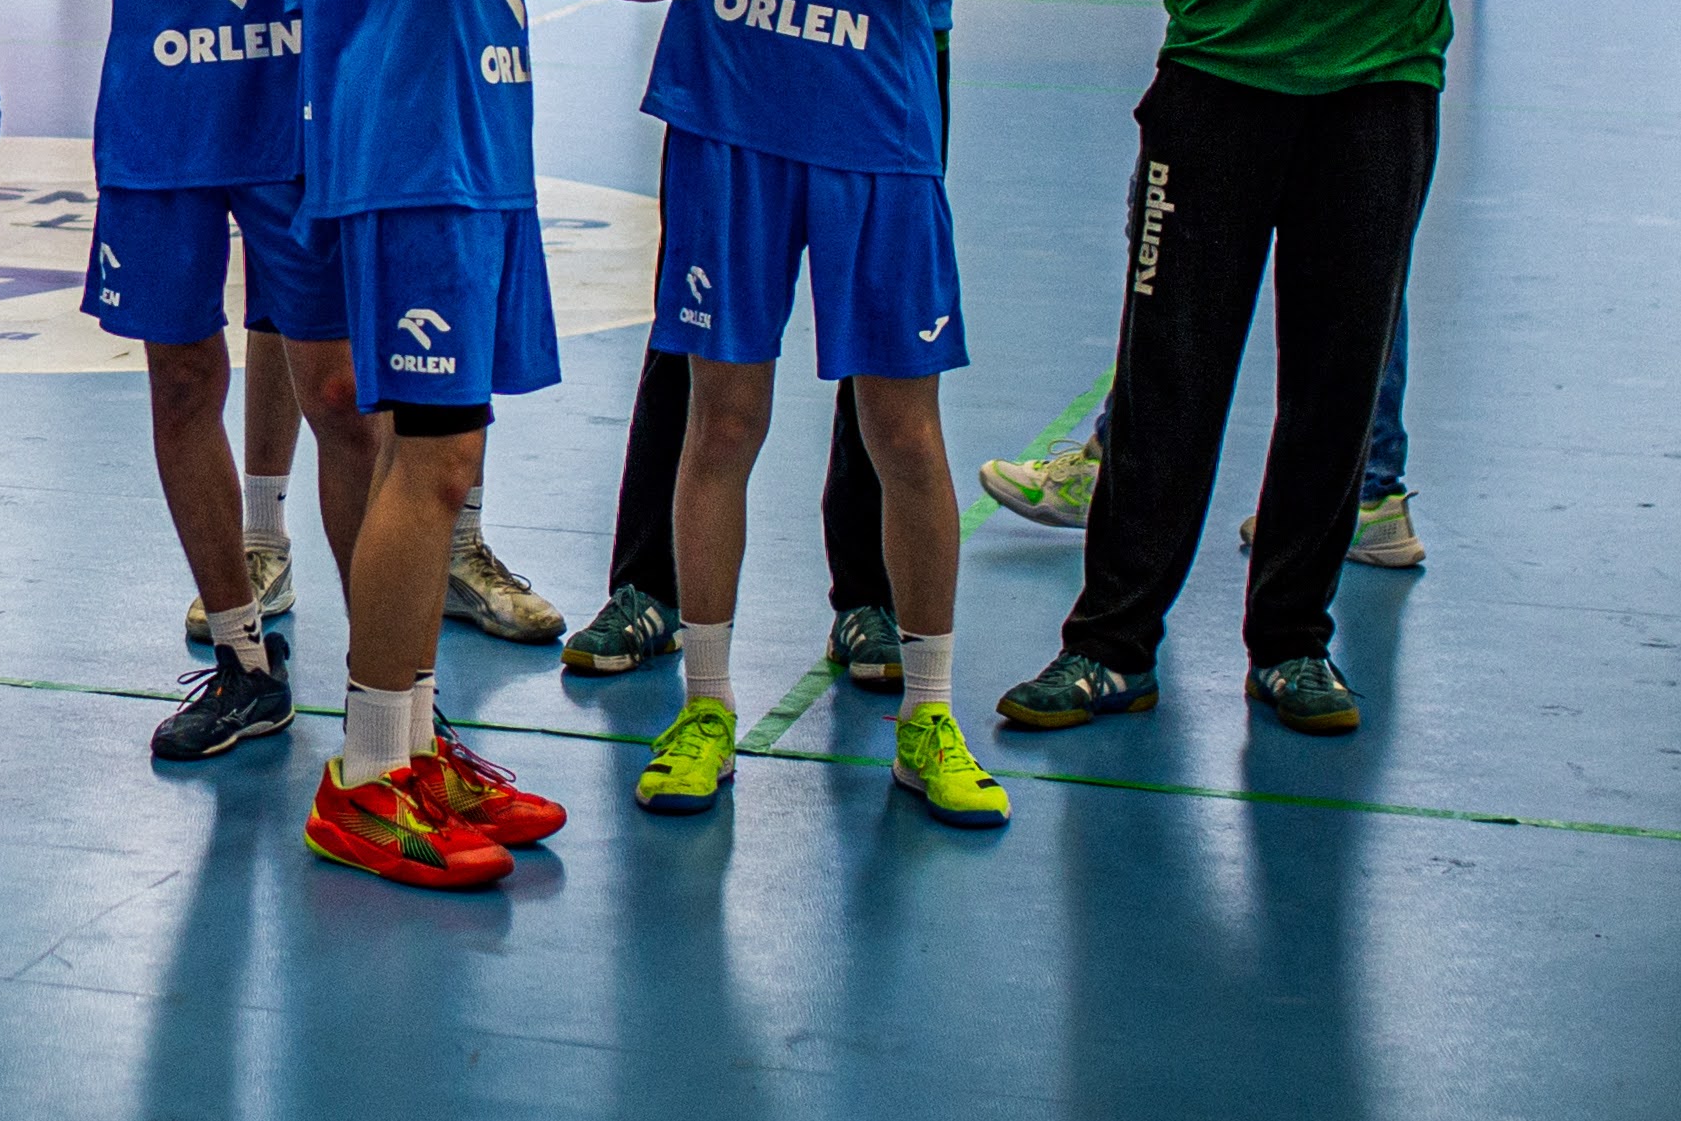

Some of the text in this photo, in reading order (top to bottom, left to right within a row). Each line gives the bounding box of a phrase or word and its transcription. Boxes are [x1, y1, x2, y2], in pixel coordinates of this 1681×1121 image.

[153, 20, 303, 67] ORLEN
[480, 45, 530, 84] ORL
[1134, 160, 1175, 296] Kempa
[679, 306, 712, 331] ORLEN
[390, 352, 456, 375] ORLEN
